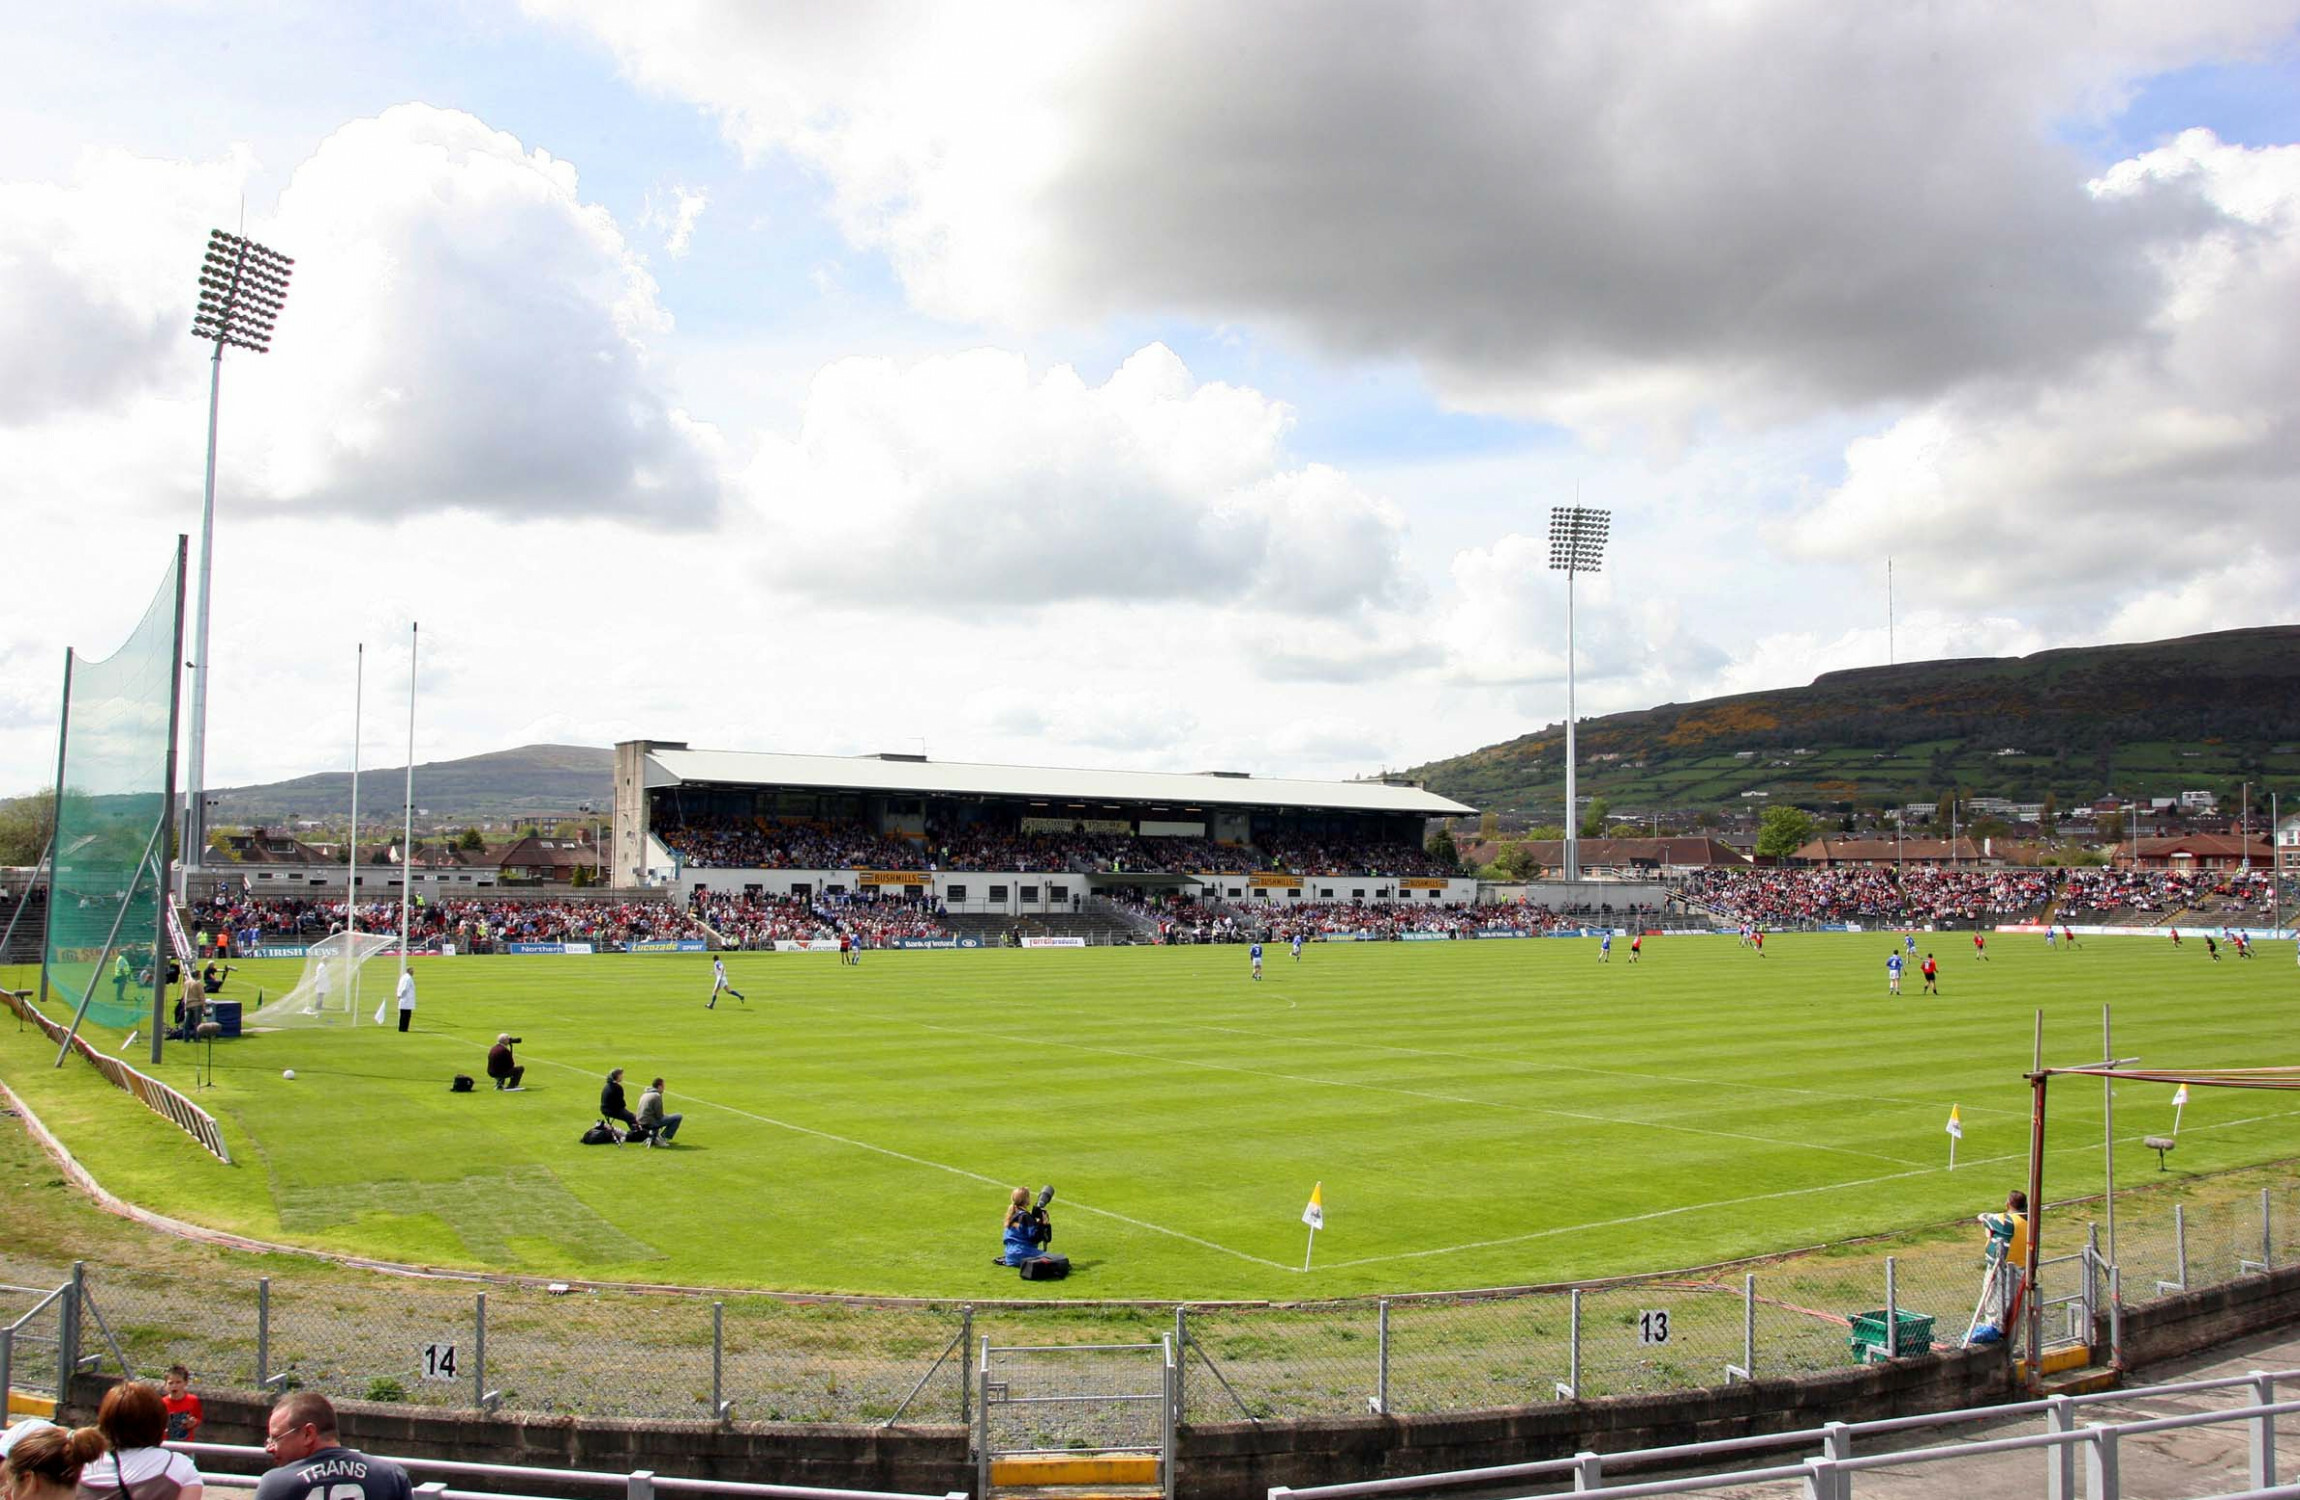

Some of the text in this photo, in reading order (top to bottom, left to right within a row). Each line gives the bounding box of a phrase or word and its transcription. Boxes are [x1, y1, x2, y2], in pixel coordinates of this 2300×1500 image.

[874, 873, 917, 883] BUSHMILLS
[521, 945, 563, 953] Northern
[905, 940, 923, 948] Bank
[268, 948, 302, 957] IRISH
[1640, 1312, 1667, 1342] 13
[425, 1344, 456, 1377] 14
[297, 1459, 368, 1483] TRANS
